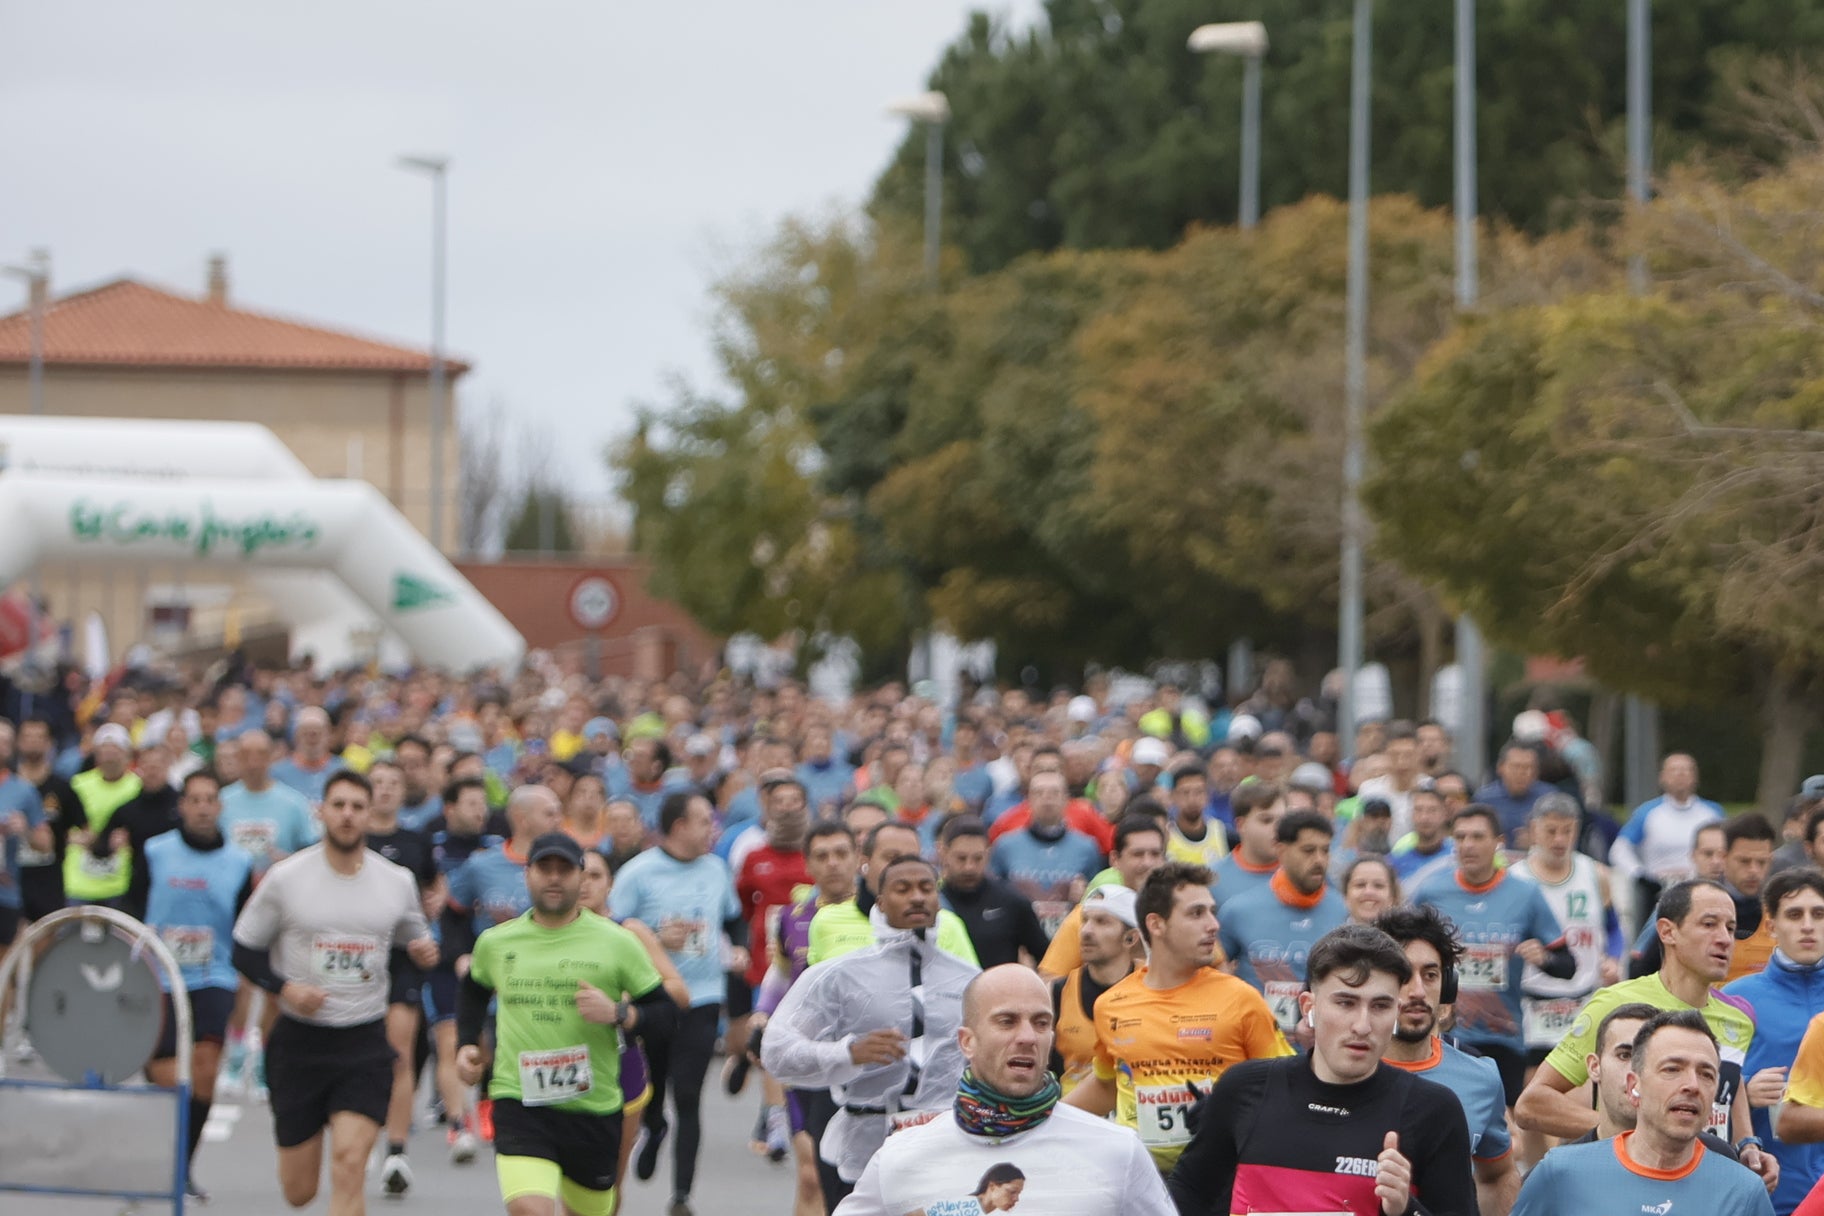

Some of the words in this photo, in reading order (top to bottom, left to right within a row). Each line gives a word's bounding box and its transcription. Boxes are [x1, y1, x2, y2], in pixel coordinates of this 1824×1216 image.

[1568, 892, 1589, 918] 12
[533, 1064, 577, 1089] 142
[1308, 1103, 1340, 1114] CRAFT
[1334, 1156, 1379, 1178] 226ER
[1641, 1204, 1663, 1215] MKA
